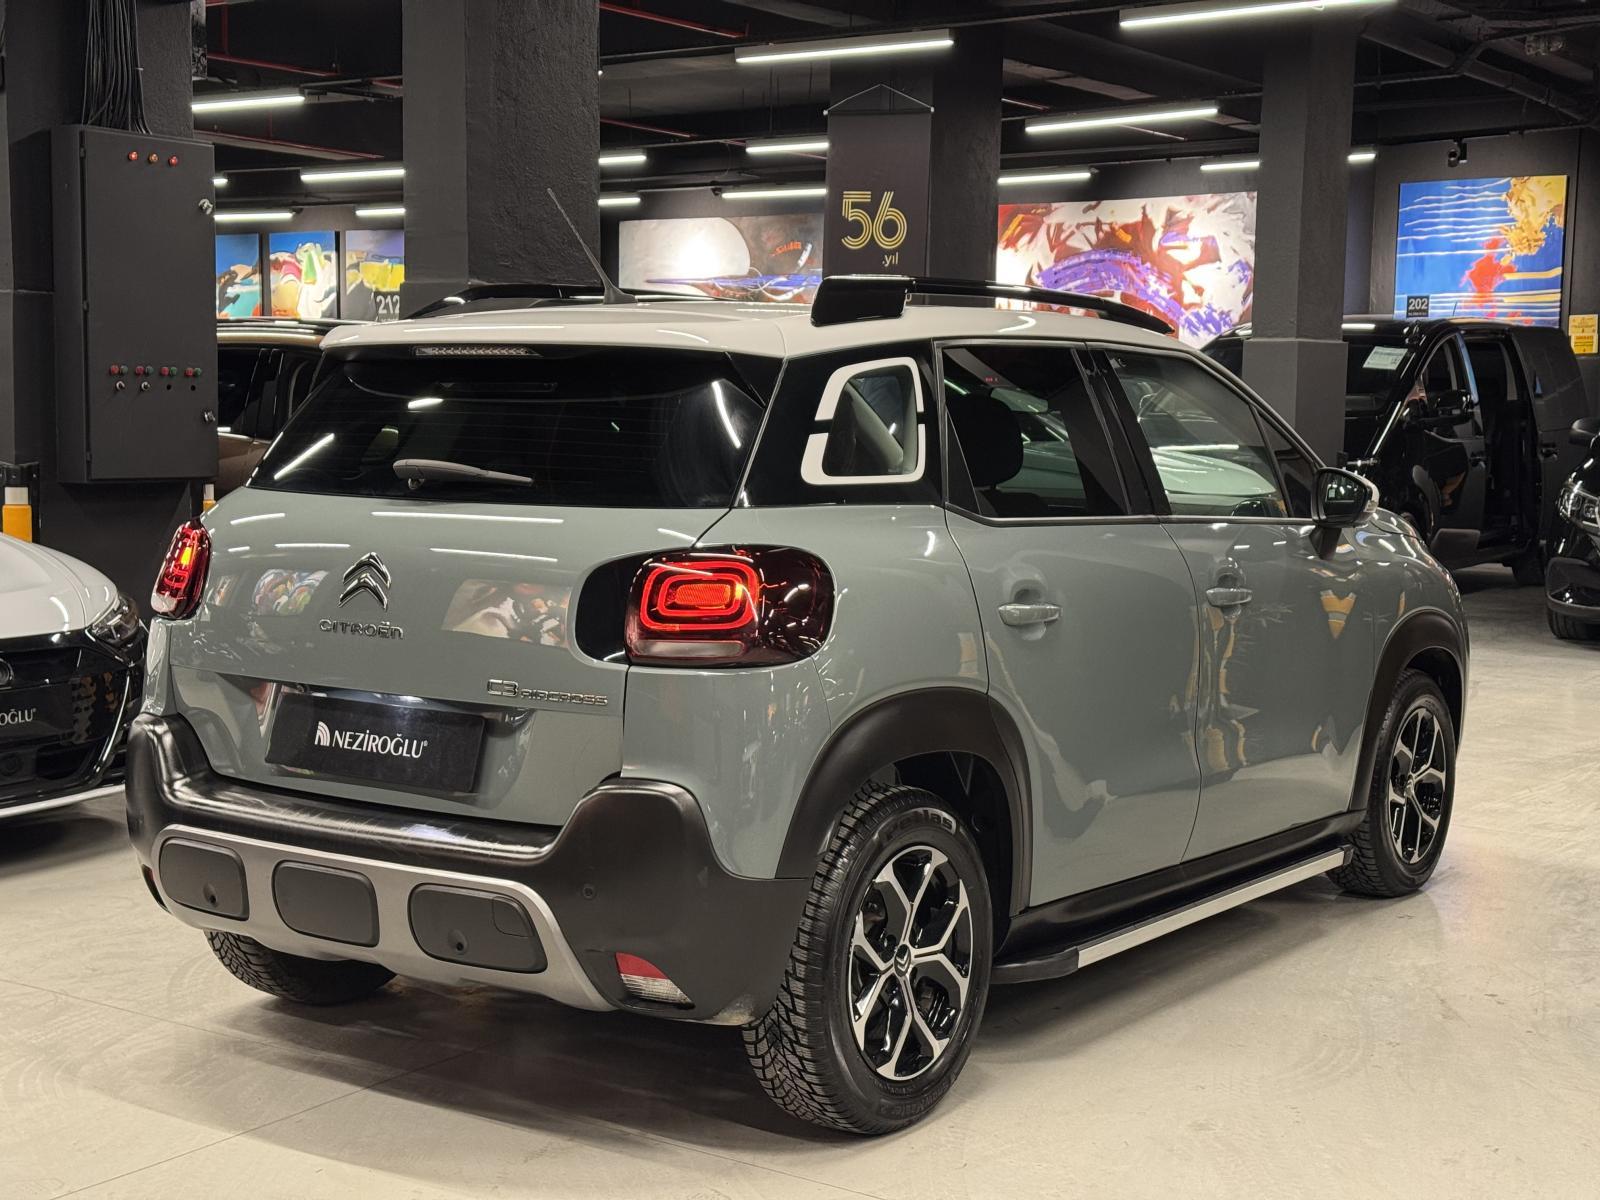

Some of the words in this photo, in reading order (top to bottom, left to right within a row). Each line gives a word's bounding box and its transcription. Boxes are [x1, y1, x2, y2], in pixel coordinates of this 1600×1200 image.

[842, 191, 907, 249] 56
[376, 295, 399, 314] 212
[1409, 298, 1428, 310] 202
[487, 679, 518, 697] C3
[520, 689, 608, 706] AIRCROSS
[332, 730, 424, 759] NEZİROĞLU
